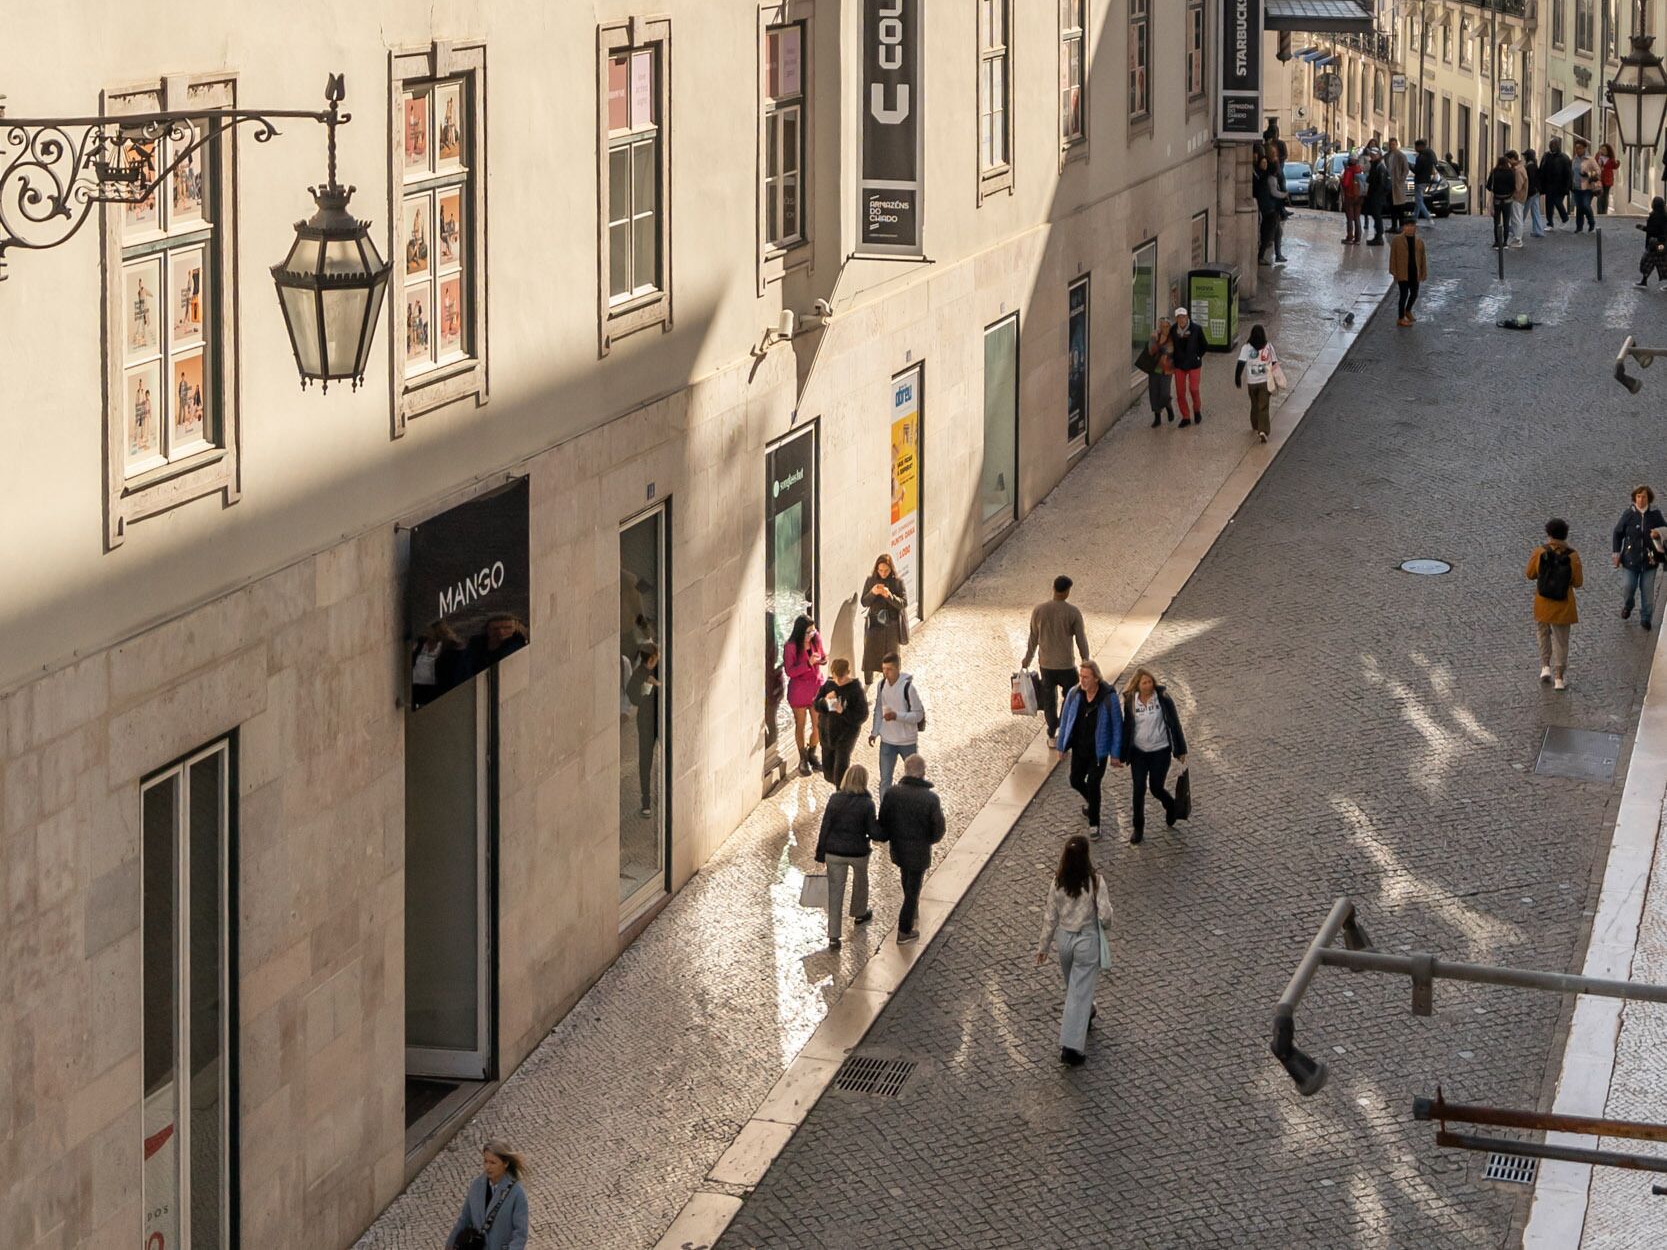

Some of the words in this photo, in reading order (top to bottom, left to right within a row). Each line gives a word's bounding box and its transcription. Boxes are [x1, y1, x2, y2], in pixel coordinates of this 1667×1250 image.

[870, 200, 909, 209] ARMAZÉNS
[870, 215, 898, 223] CHIADO
[439, 561, 505, 619] MANGO
